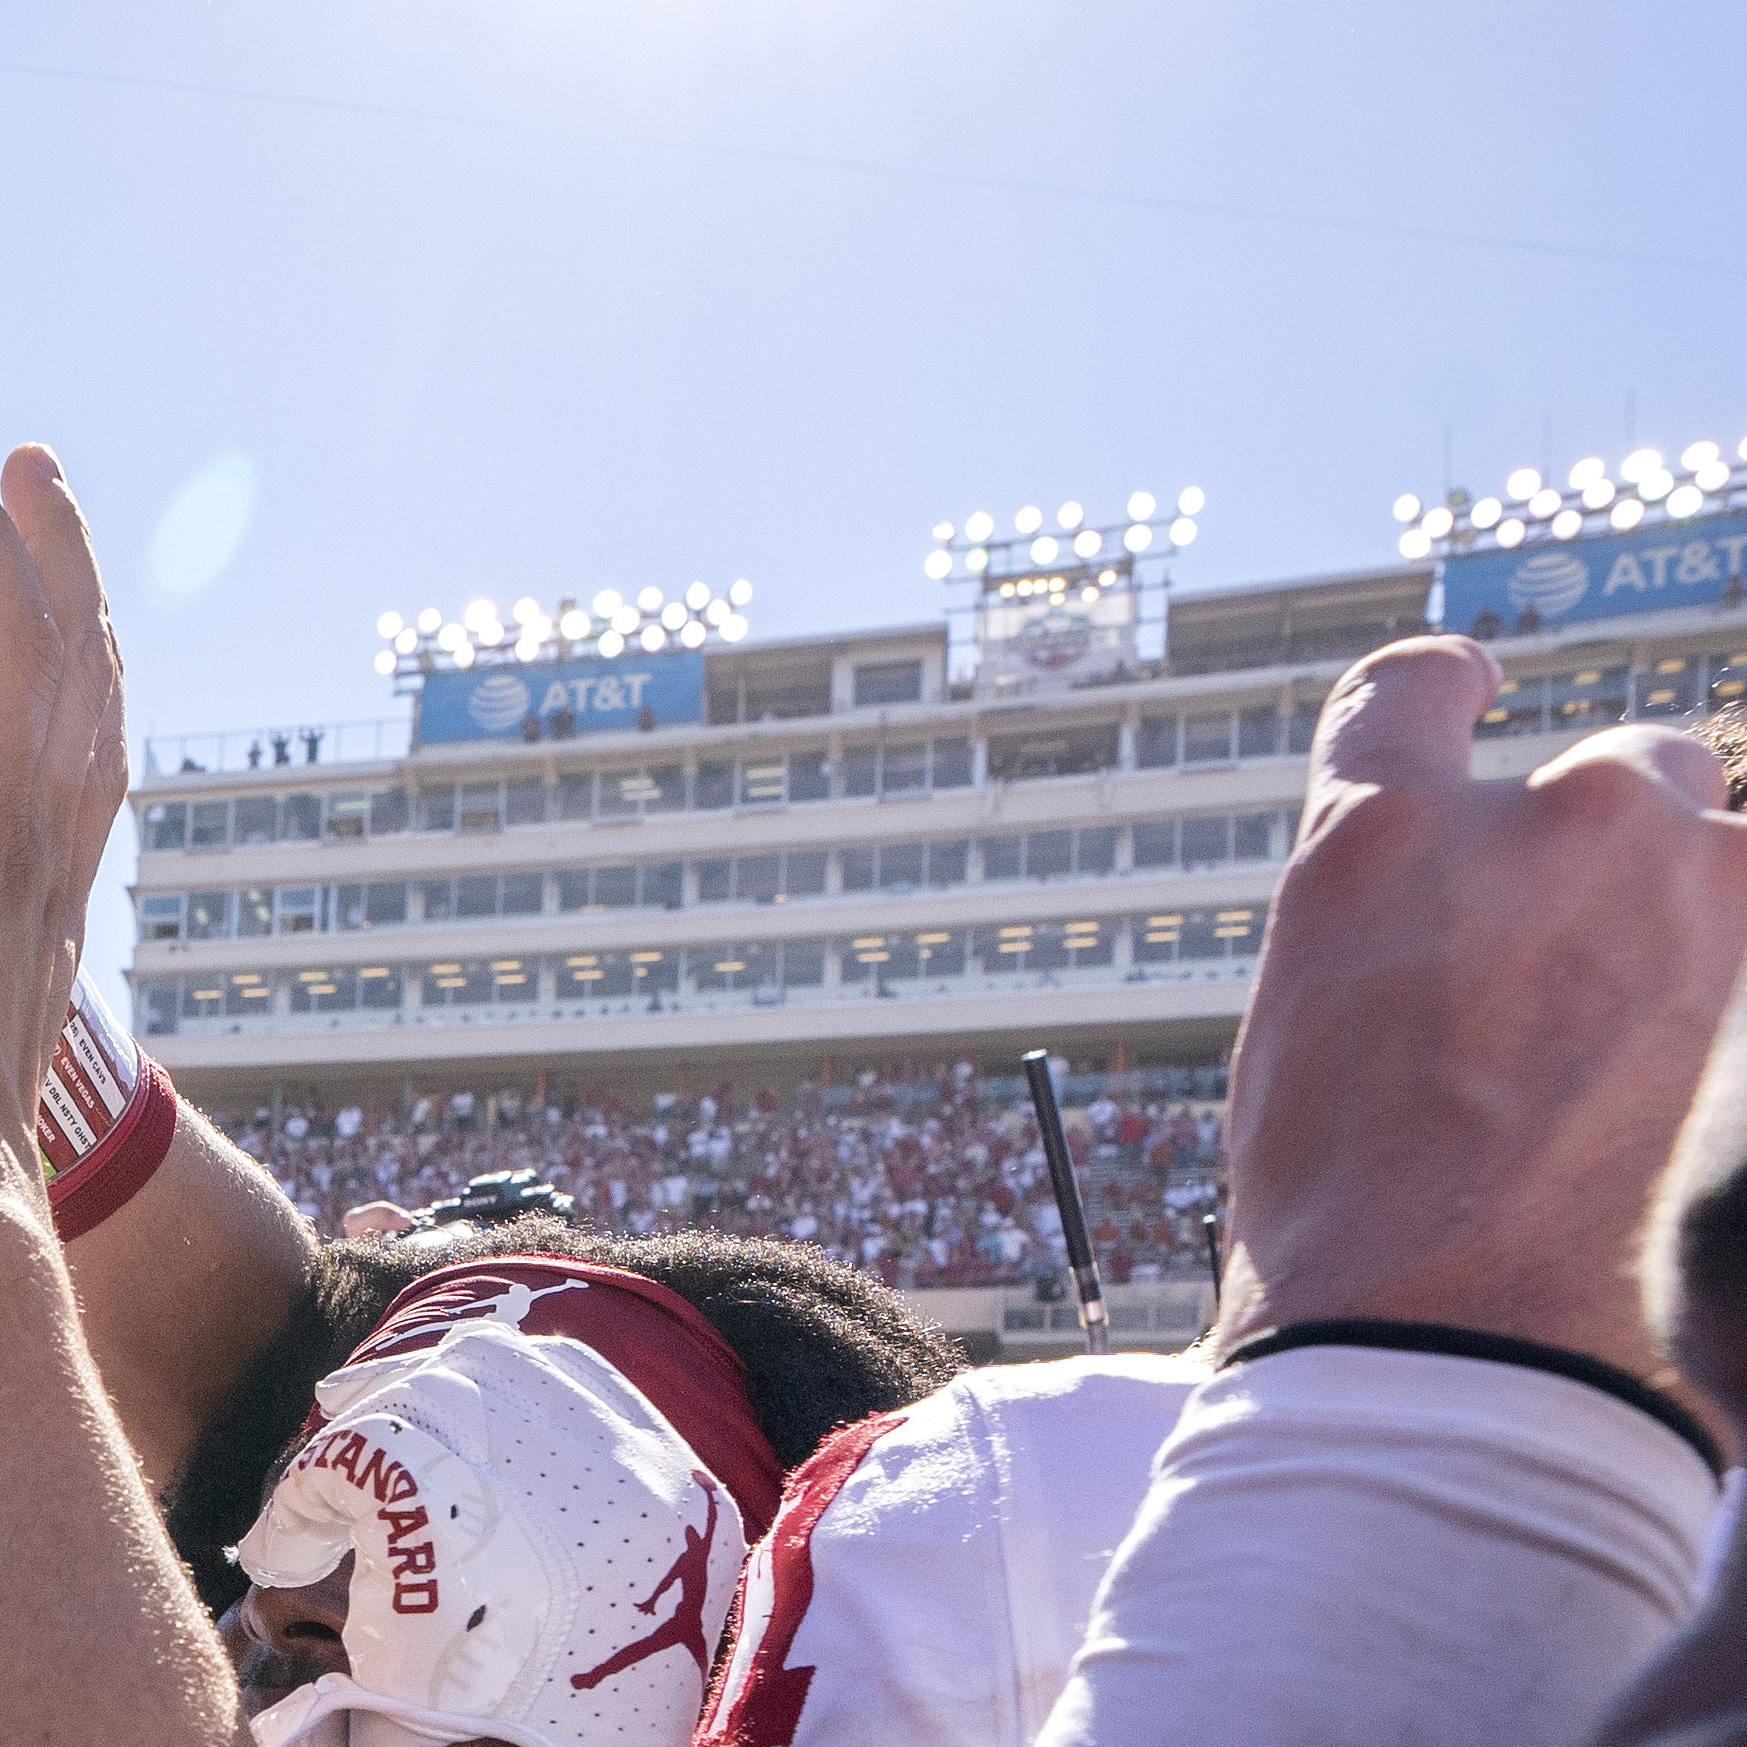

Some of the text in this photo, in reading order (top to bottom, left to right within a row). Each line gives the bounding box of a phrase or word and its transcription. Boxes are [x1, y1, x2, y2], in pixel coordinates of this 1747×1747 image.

[1601, 536, 1747, 597] AT&T
[537, 672, 653, 716] AT&T
[61, 1057, 79, 1082] EVEN
[75, 1079, 95, 1110] VEGAS
[79, 1039, 94, 1062] EVEN
[92, 1062, 107, 1085] CAVS
[49, 1086, 62, 1105] DBL
[60, 1104, 77, 1127] NSTY
[74, 1126, 91, 1151] GHST
